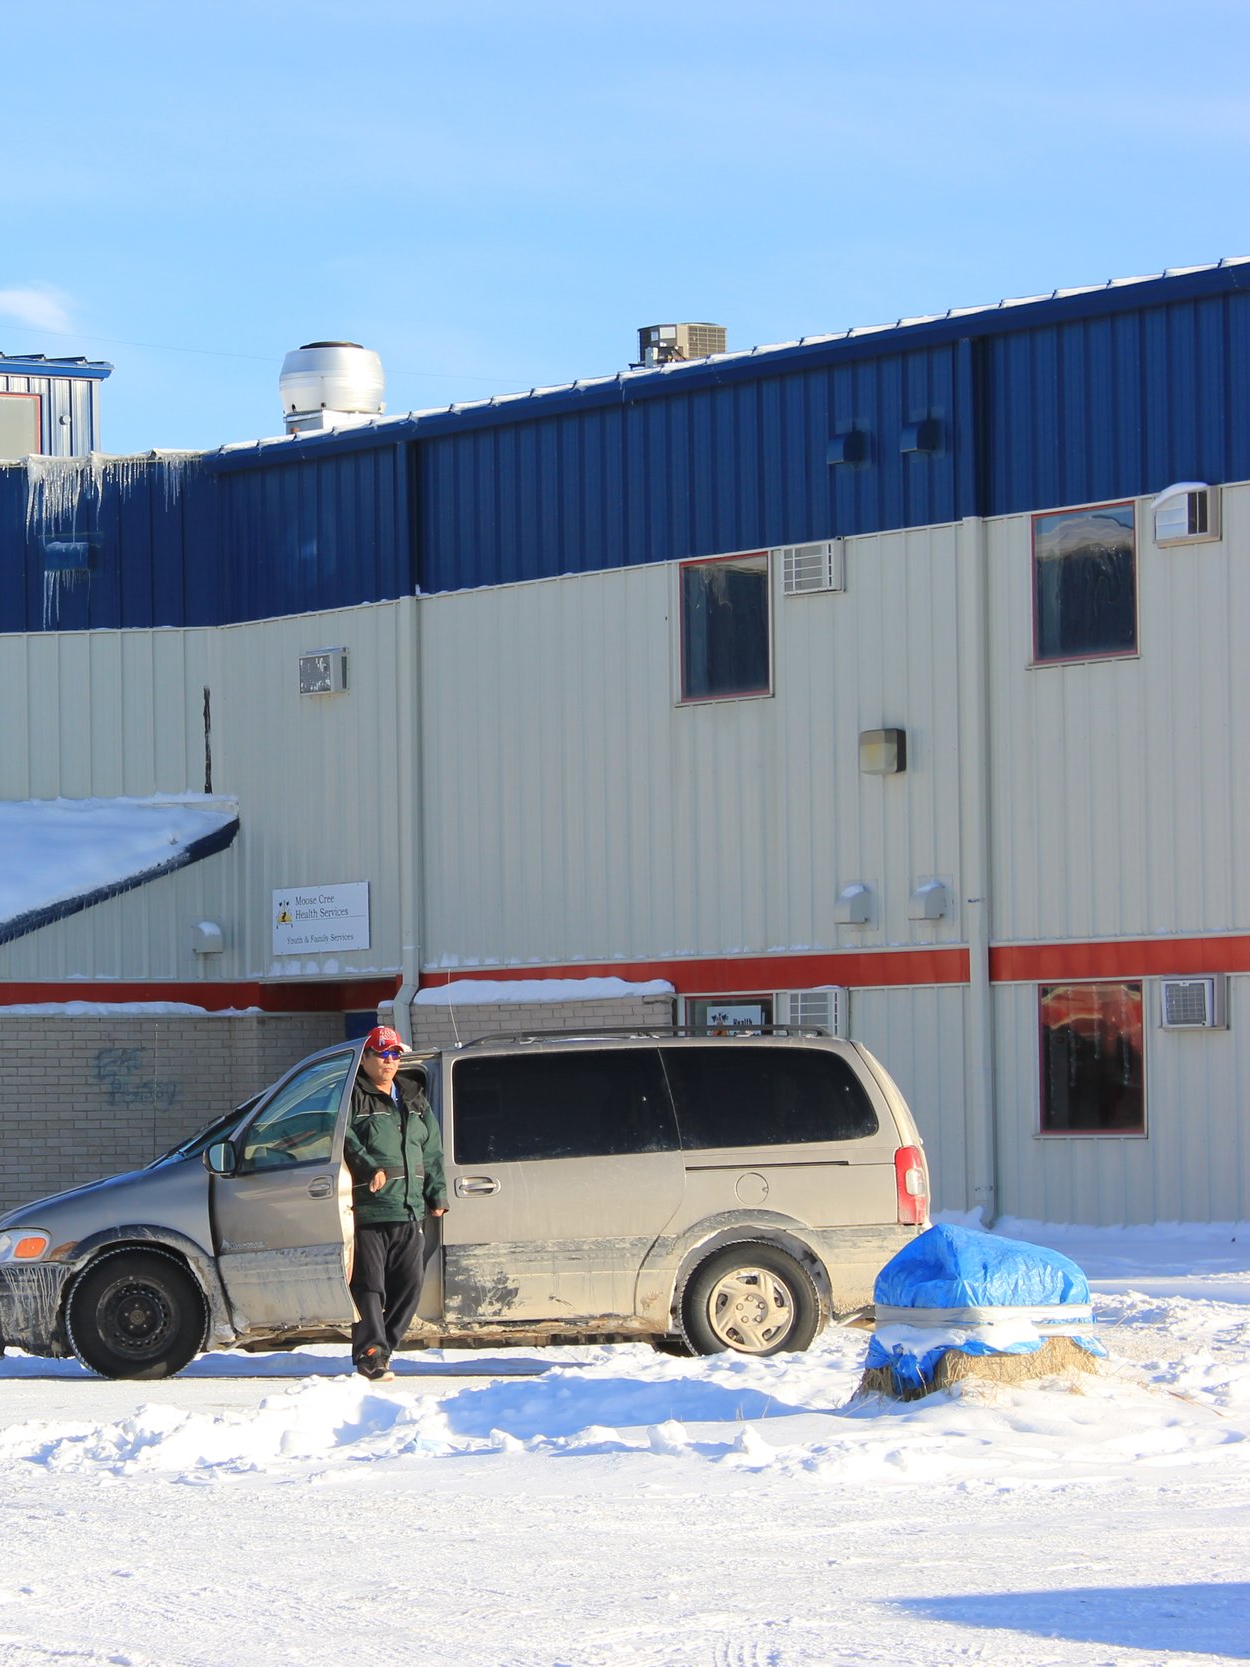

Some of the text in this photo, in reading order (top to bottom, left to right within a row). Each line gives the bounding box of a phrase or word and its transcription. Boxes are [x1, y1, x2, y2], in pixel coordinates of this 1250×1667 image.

[295, 894, 334, 905] Moose Cree
[295, 907, 349, 919] Health Services
[287, 936, 303, 944] Youth
[310, 934, 329, 944] Family
[330, 933, 354, 942] Services
